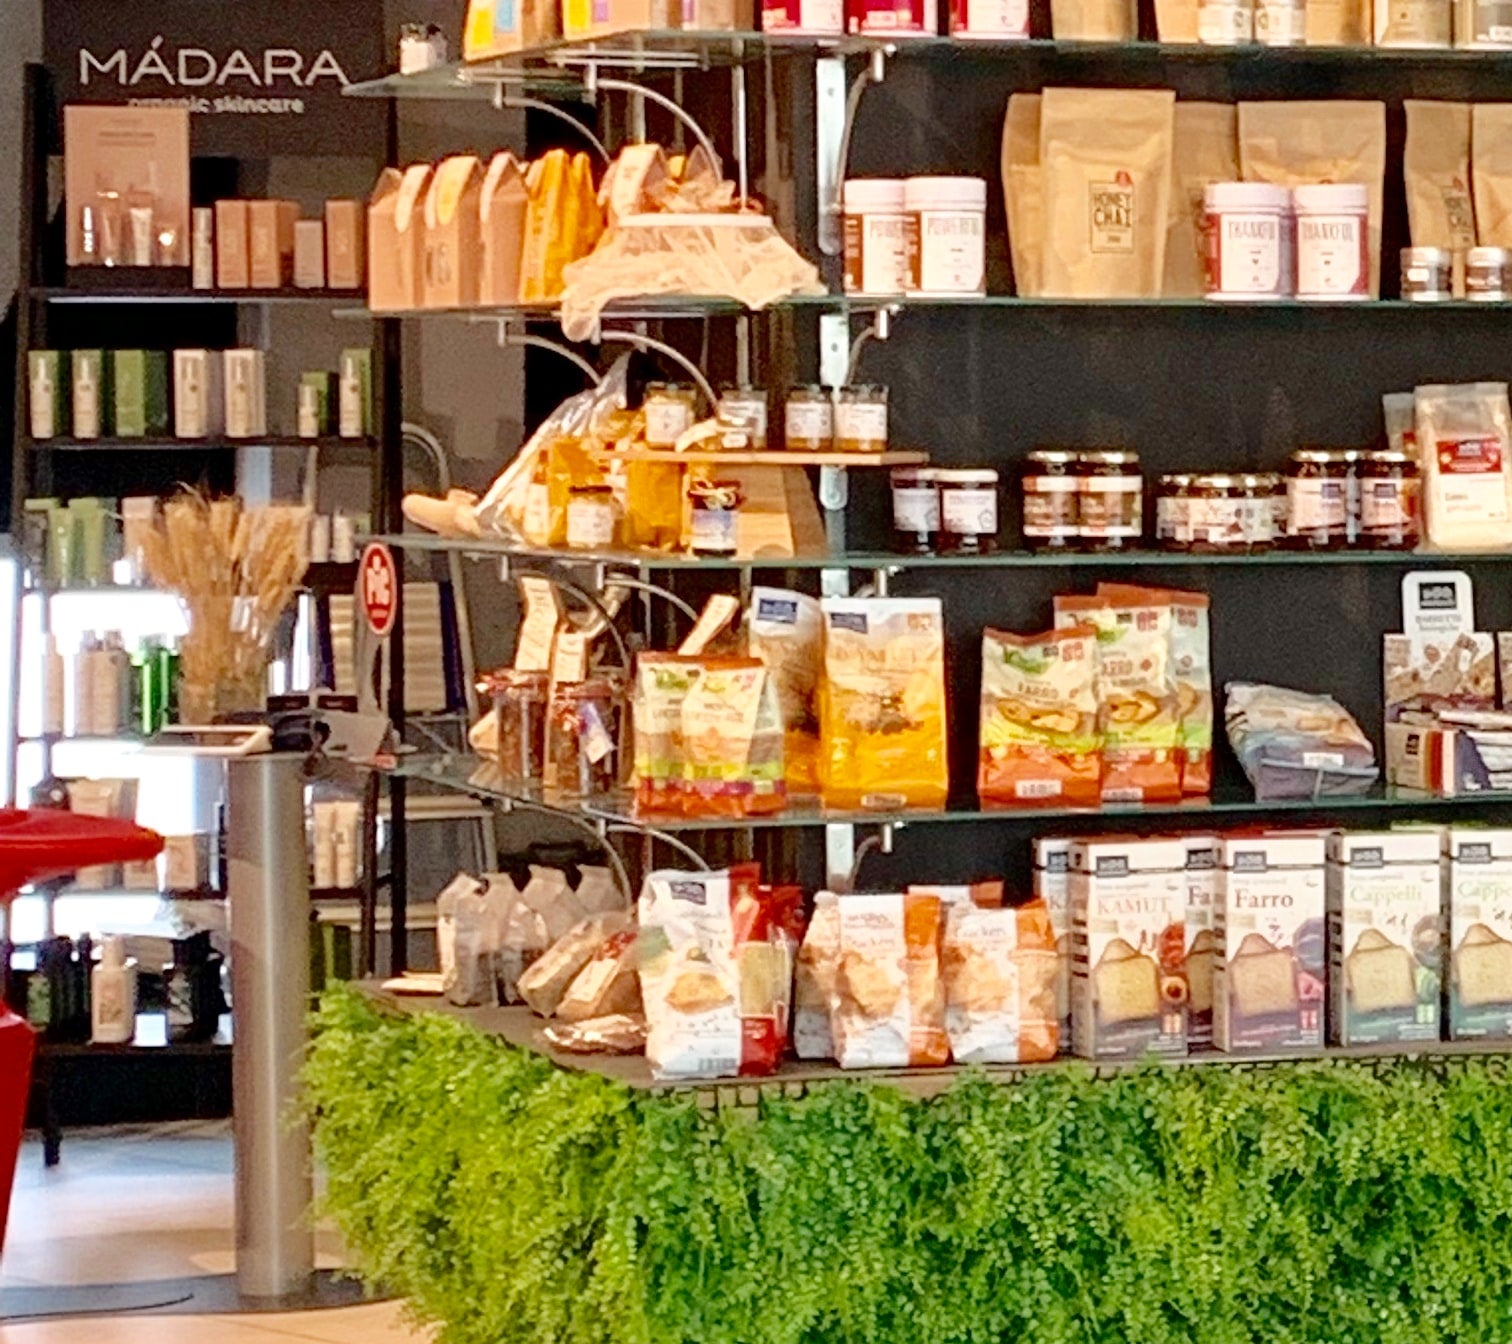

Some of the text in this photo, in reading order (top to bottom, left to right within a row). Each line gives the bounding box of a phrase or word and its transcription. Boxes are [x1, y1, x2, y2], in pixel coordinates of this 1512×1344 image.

[79, 34, 350, 86] MÁDARA
[213, 95, 305, 114] skincare
[1094, 207, 1131, 228] CHAI
[1235, 888, 1295, 908] Farro
[1350, 885, 1424, 906] Cappelli
